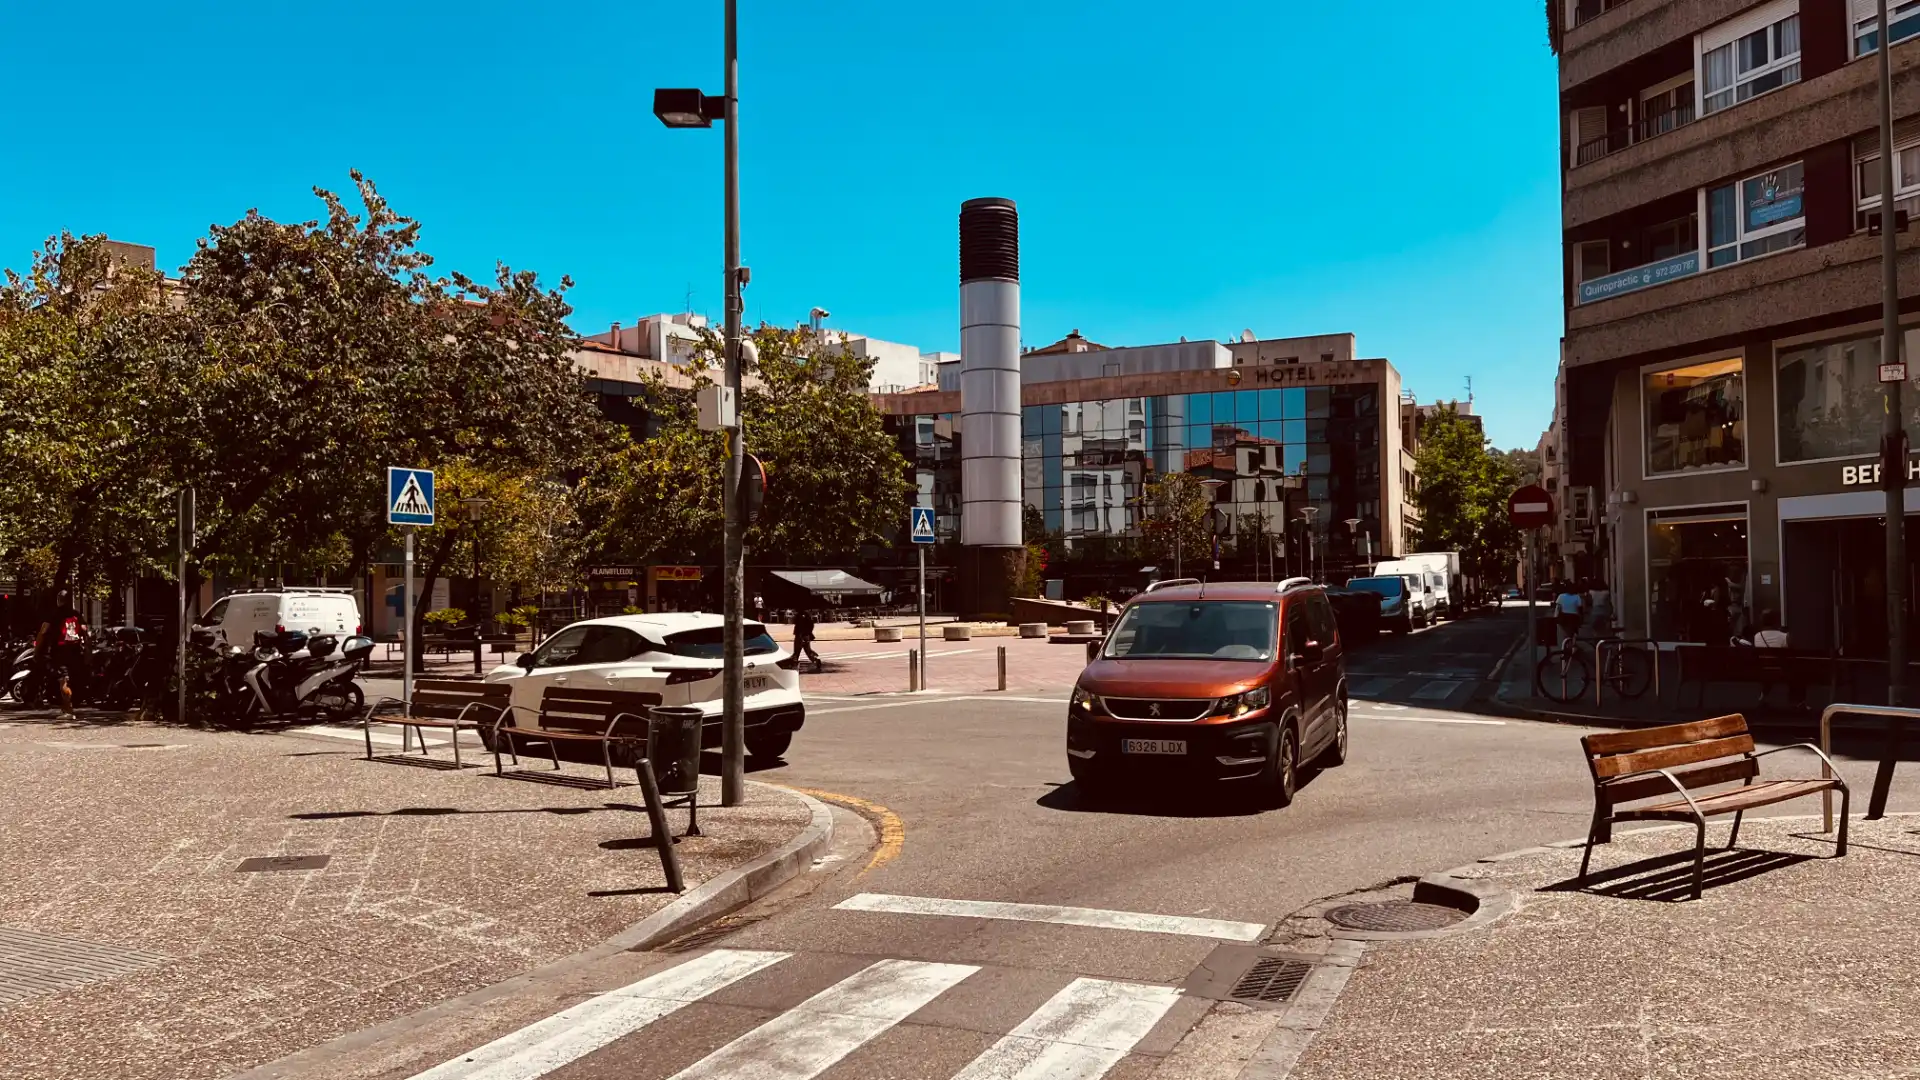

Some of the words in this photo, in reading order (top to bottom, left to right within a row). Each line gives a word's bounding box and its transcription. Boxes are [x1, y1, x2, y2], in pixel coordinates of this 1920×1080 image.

[1585, 274, 1639, 296] Quiropràctic
[1655, 267, 1668, 278] 972
[1668, 264, 1682, 275] 220
[1256, 366, 1315, 383] HOTEL
[1129, 741, 1157, 753] 6326
[1161, 742, 1183, 753] LDX
